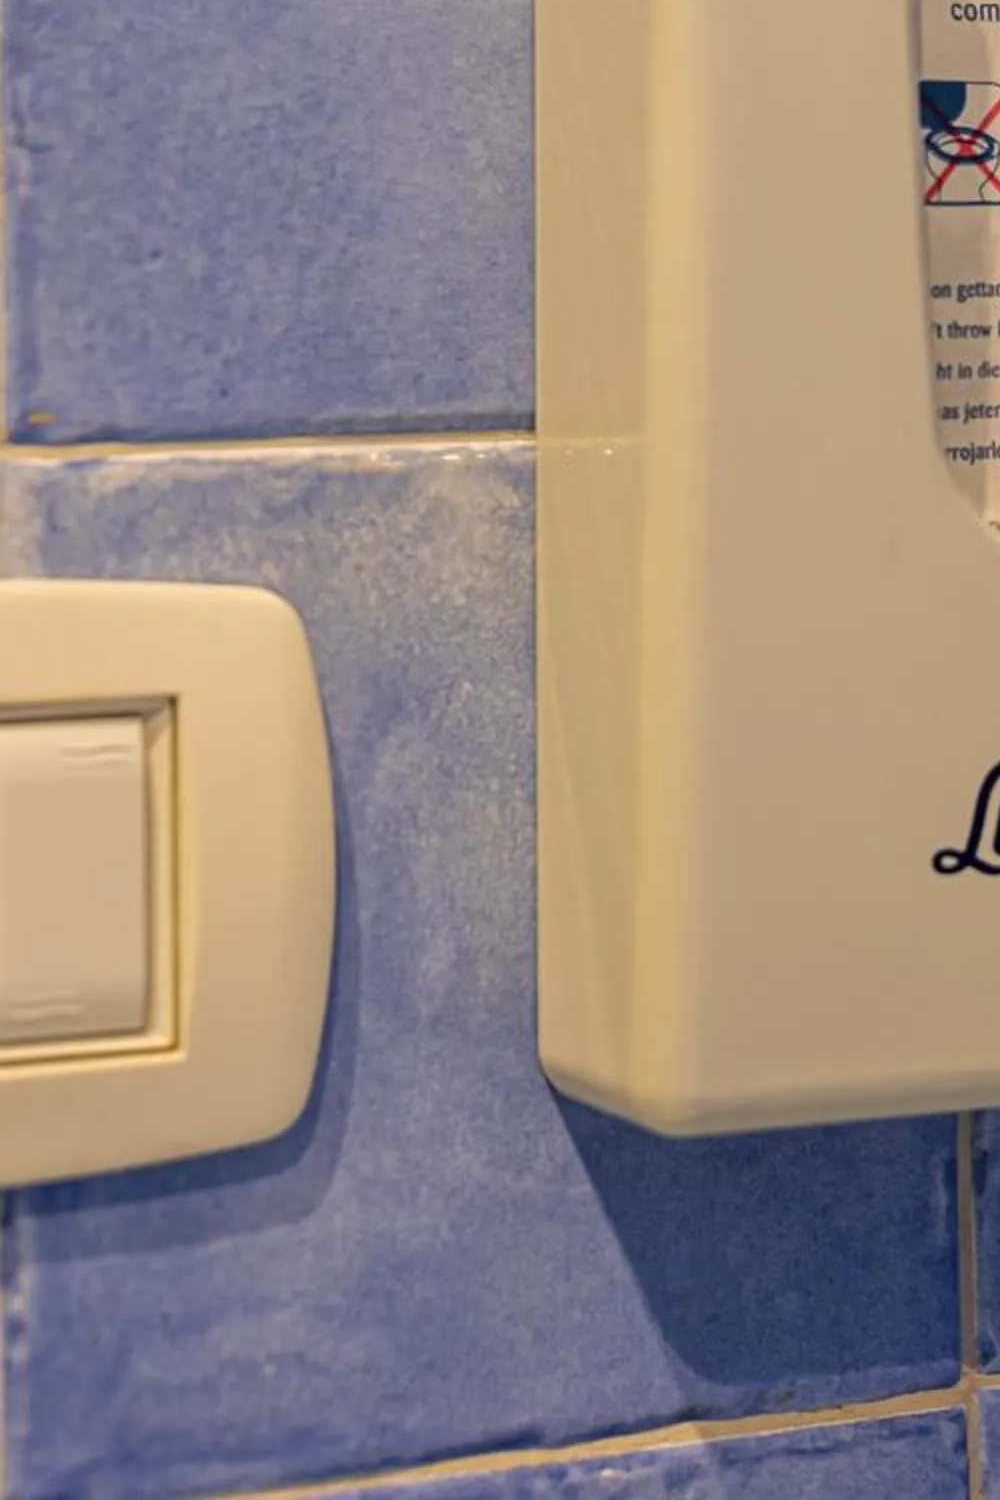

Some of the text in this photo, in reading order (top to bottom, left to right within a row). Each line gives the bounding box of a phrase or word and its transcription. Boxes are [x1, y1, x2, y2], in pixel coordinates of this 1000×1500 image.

[947, 319, 992, 339] throw
[958, 361, 972, 379] in
[977, 360, 1000, 378] die
